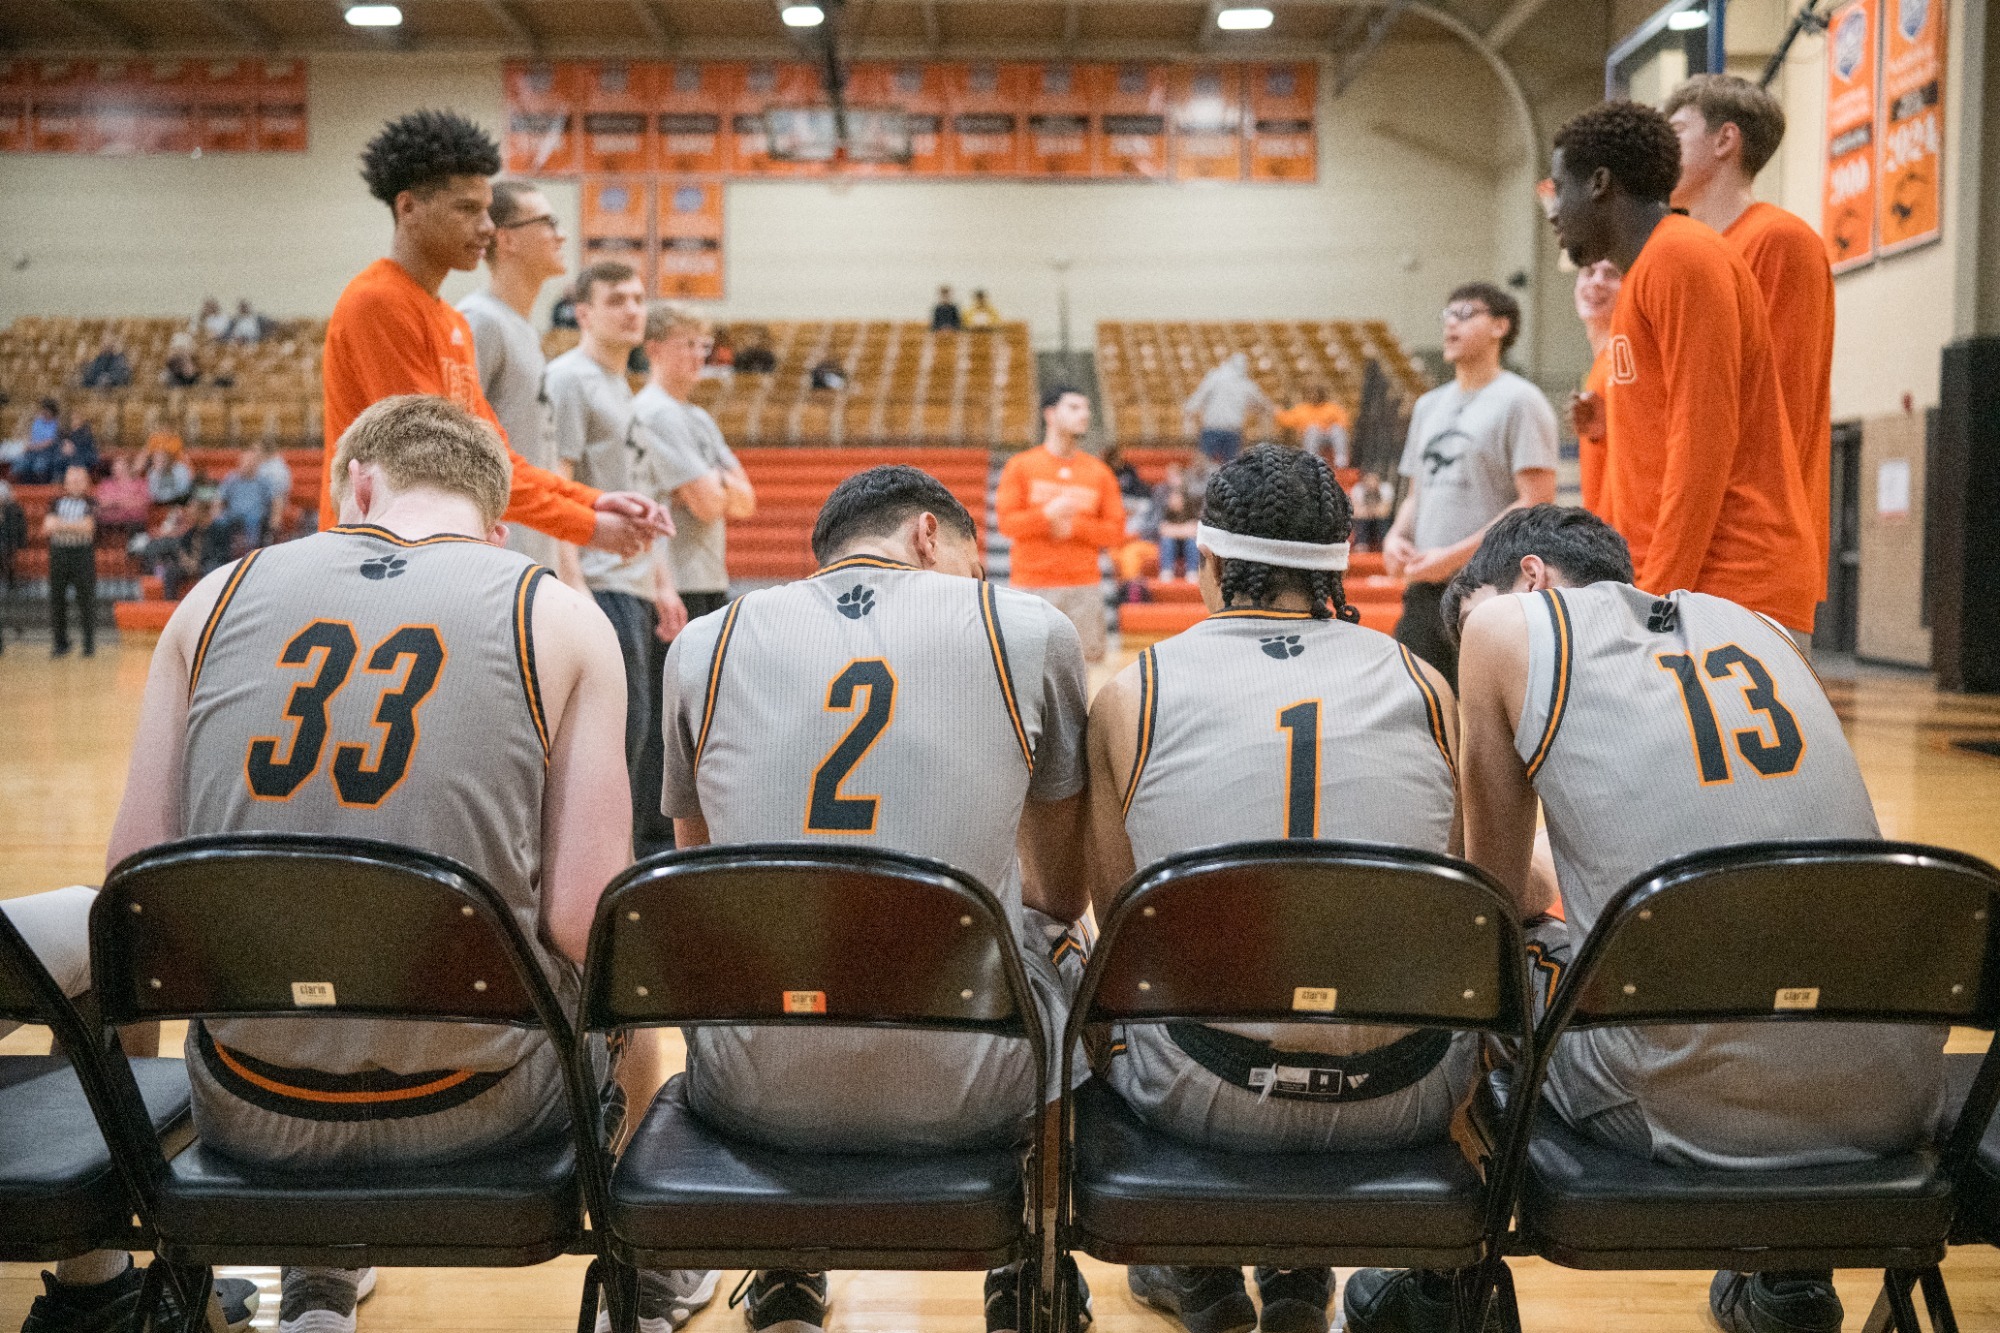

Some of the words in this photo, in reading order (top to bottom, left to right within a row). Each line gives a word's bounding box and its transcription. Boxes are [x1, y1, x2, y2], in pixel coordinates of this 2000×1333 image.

[244, 617, 449, 810] 33
[803, 656, 899, 835] 2
[1275, 697, 1322, 840] 1
[1653, 641, 1808, 787] 13
